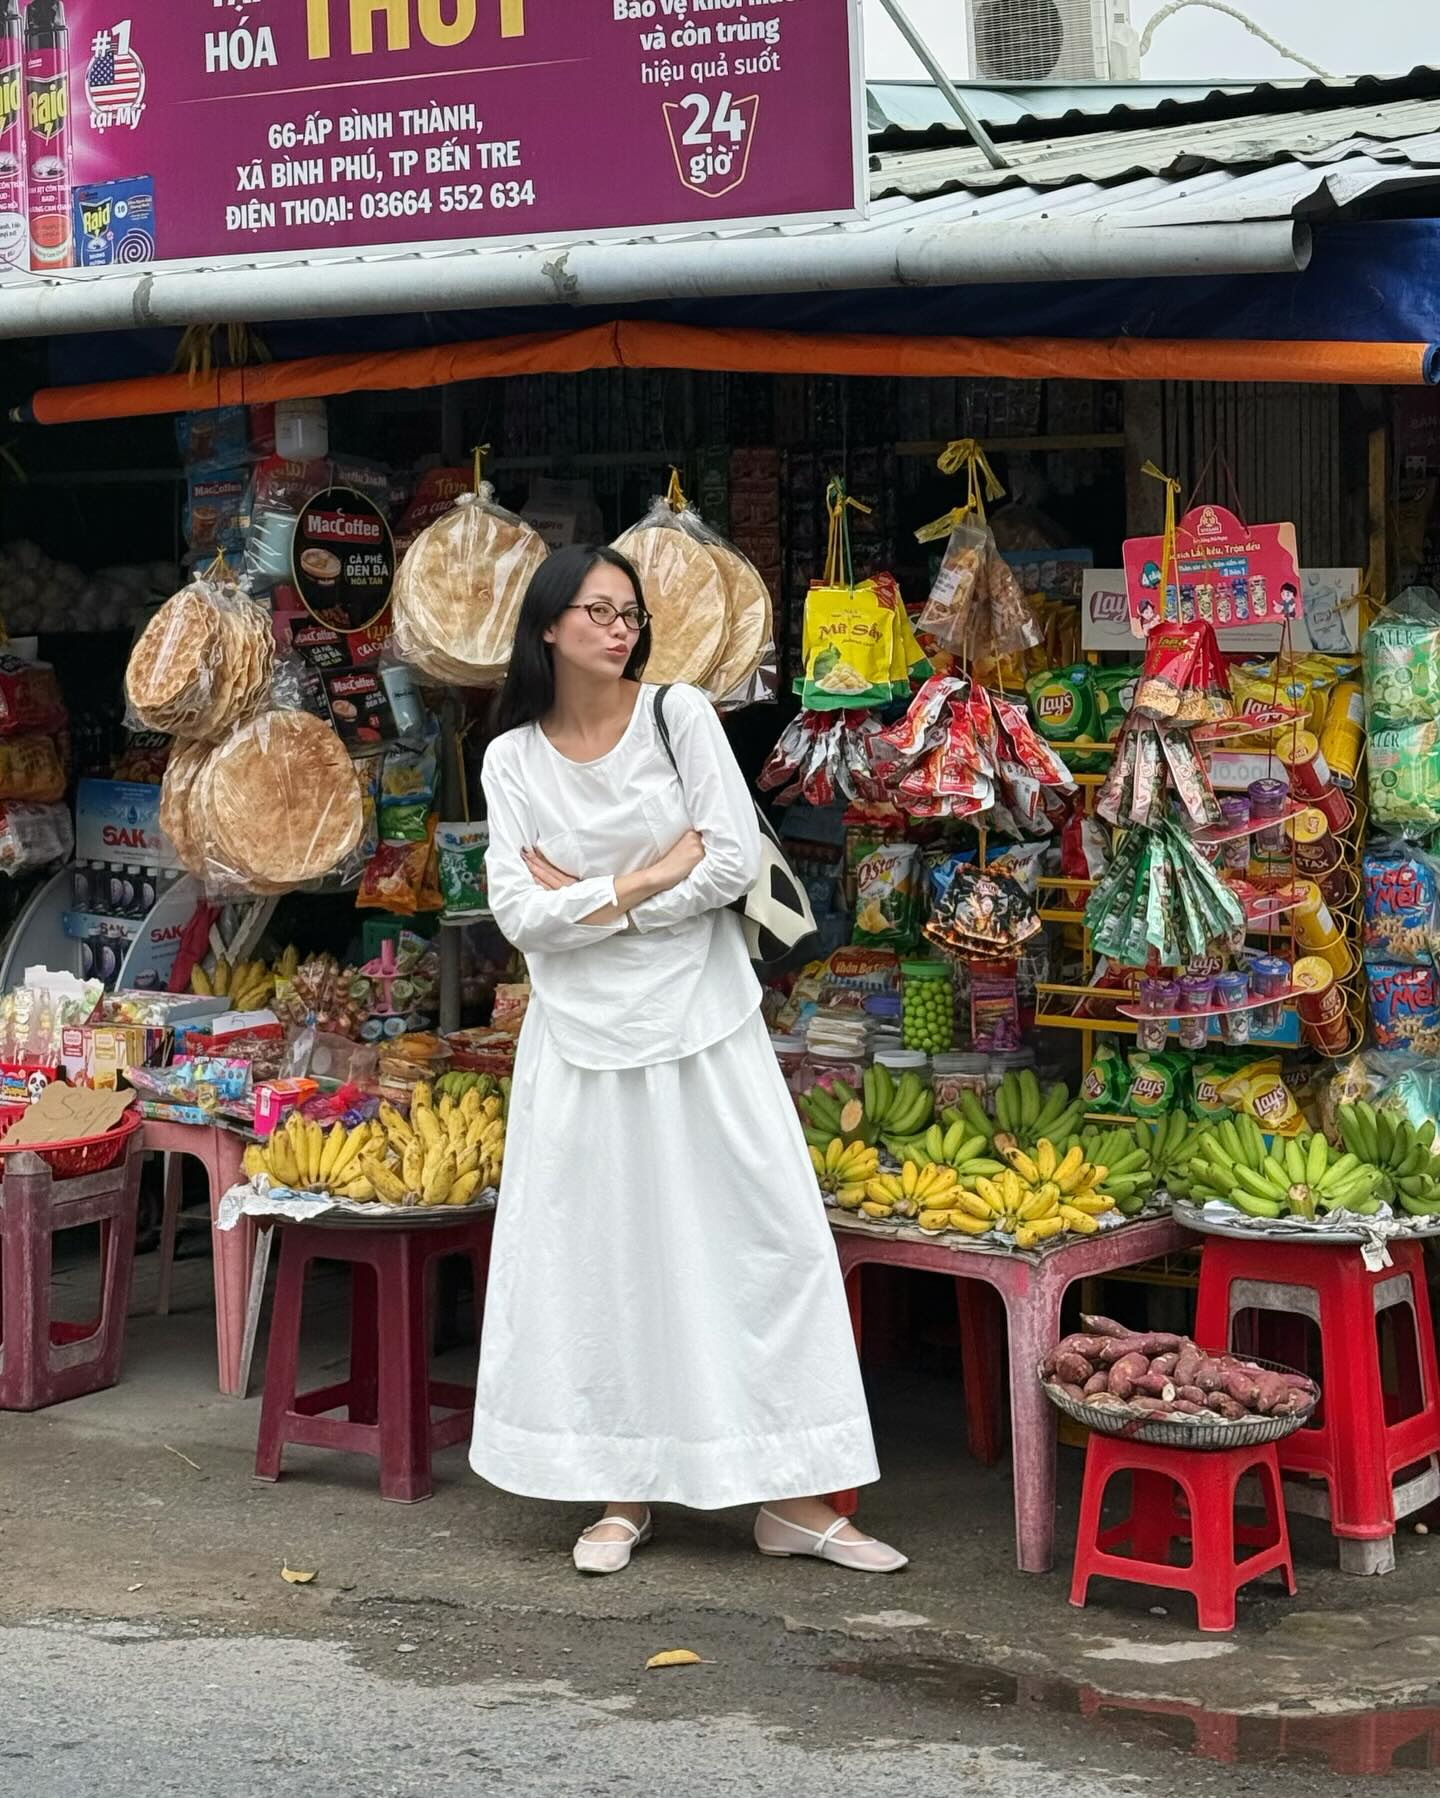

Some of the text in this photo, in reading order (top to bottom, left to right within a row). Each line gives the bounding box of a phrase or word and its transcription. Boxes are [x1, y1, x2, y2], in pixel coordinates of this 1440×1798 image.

[91, 20, 131, 57] #1
[204, 16, 278, 72] HÓA
[640, 15, 781, 51] và côn trùng
[641, 46, 781, 87] hiệu quả suốt
[28, 79, 67, 130] Raid
[680, 91, 746, 145] 24
[268, 100, 483, 149] 66-ẤP BÌNH THÀNH,
[236, 137, 521, 191] XÃ BÌNH PHÚ, TP BẾN TRE
[690, 145, 733, 184] giờ
[83, 203, 111, 234] Raid
[226, 180, 536, 233] ĐIỆN THOẠI: 03664 552 634
[307, 515, 380, 536] MacCoffee
[1093, 591, 1128, 622] Lay
[1039, 694, 1073, 716] Lay's
[1132, 1076, 1165, 1099] Lay's
[1197, 1082, 1218, 1103] Lay
[1253, 1085, 1287, 1117] Lay's
